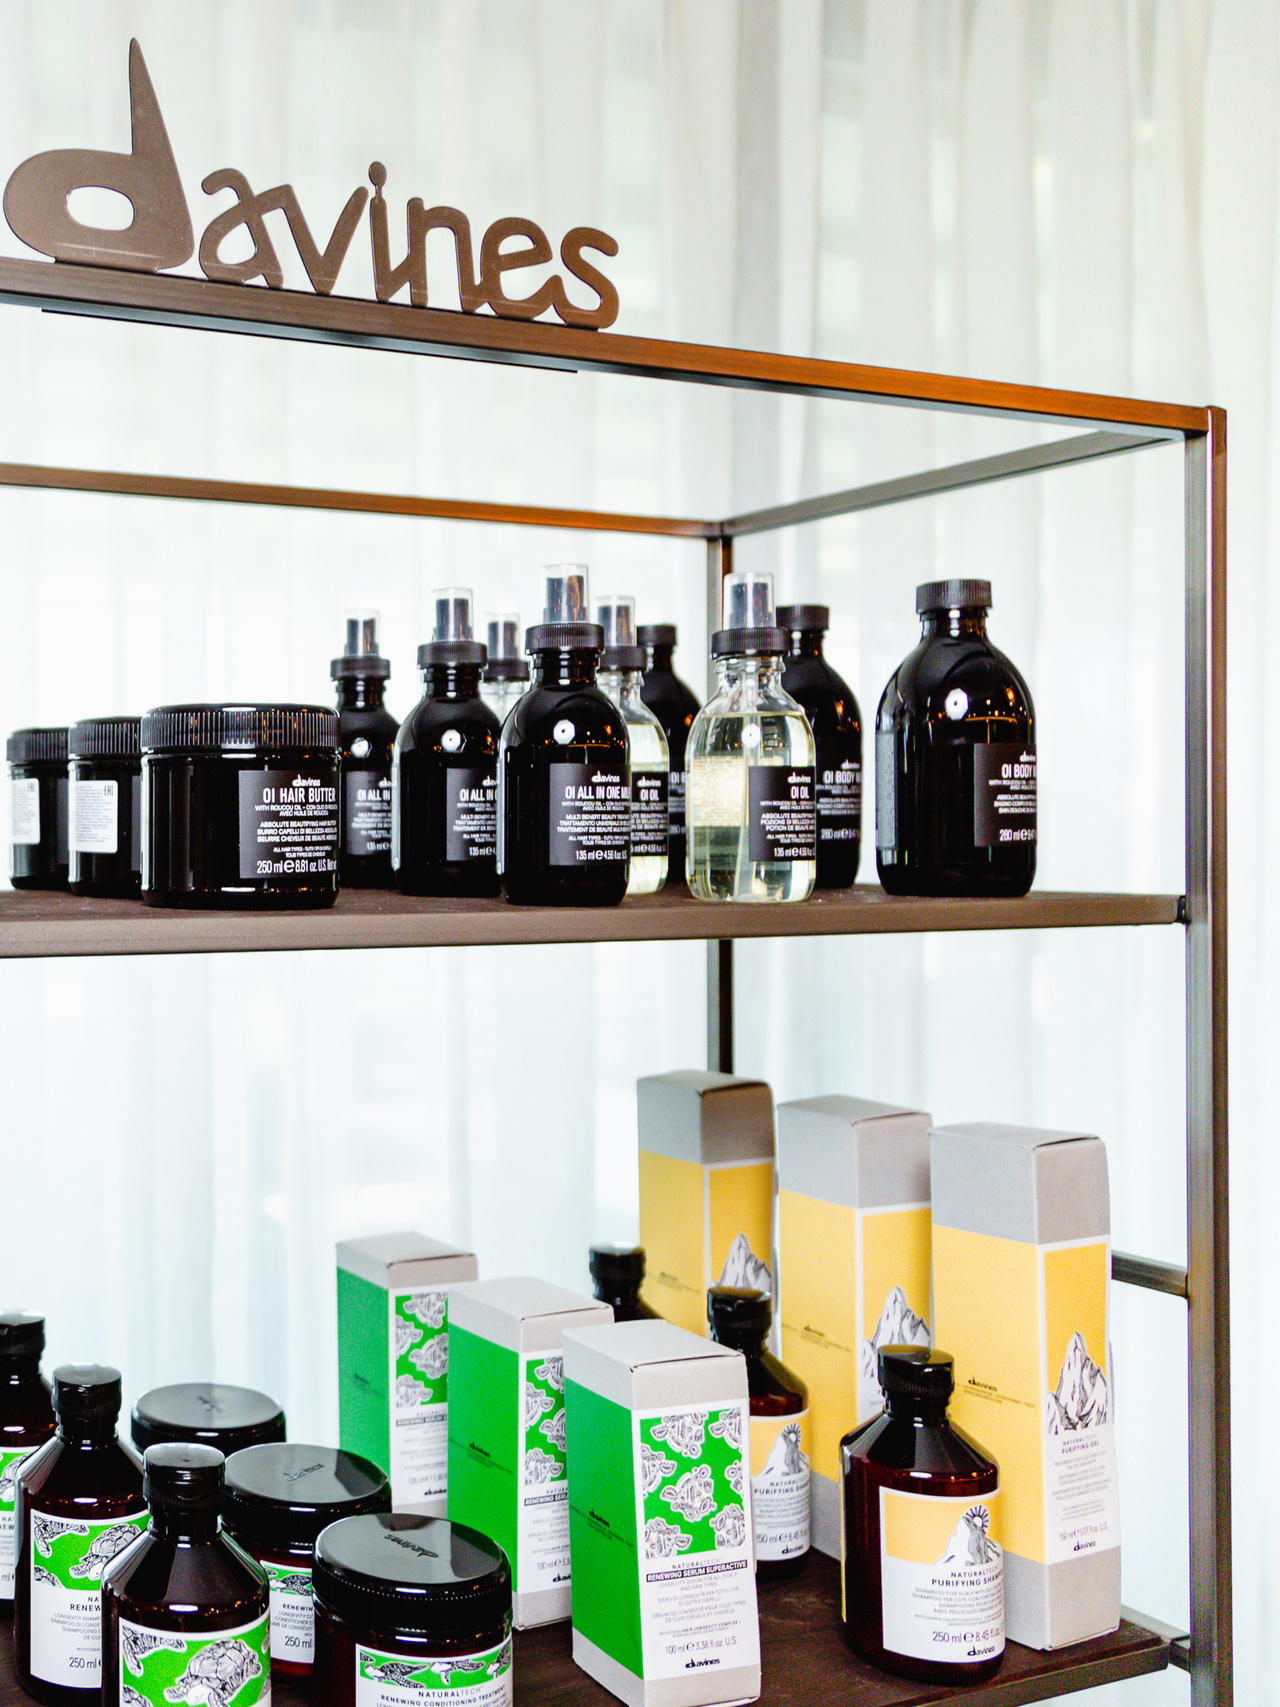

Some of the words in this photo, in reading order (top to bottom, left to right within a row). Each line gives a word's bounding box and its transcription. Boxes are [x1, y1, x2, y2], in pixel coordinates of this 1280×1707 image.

[2, 37, 620, 330] davines
[591, 770, 620, 783] davines
[1013, 763, 1032, 778] BODY
[292, 773, 320, 787] davines
[835, 770, 855, 784] BODY
[262, 787, 276, 803] OI
[280, 787, 305, 803] HAIR
[308, 787, 336, 803] BUTTER
[368, 789, 382, 801] ALL
[383, 789, 391, 800] IN
[470, 789, 485, 801] ALL
[486, 789, 494, 801] IN
[565, 786, 576, 799] OI
[577, 786, 595, 799] ALL
[596, 786, 605, 799] IN
[606, 786, 620, 799] ONE
[649, 789, 659, 801] OIL
[791, 786, 799, 799] OI
[800, 786, 810, 799] OIL
[257, 860, 273, 874] 250
[273, 860, 283, 873] ml
[1061, 1443, 1089, 1454] PURIFYING
[1090, 1440, 1100, 1448] GEL
[754, 1487, 794, 1495] PURIFYING
[1073, 1540, 1096, 1551] davines
[1, 1571, 11, 1581] ml
[647, 1571, 683, 1581] RENEWING
[683, 1567, 706, 1578] SERUM
[706, 1560, 747, 1574] SUPERACTIVE
[931, 1578, 981, 1587] PURIFYING
[285, 1636, 300, 1647] 250
[302, 1638, 312, 1648] ml
[932, 1631, 950, 1643] 250
[951, 1632, 962, 1643] ml
[665, 1645, 677, 1654] 100
[677, 1644, 685, 1653] ml
[967, 1645, 995, 1656] davines
[69, 1657, 85, 1668] 250
[86, 1658, 97, 1669] ml
[685, 1658, 721, 1669] davines
[381, 1695, 421, 1706] RENEWING
[424, 1697, 477, 1707] CONDITIONING
